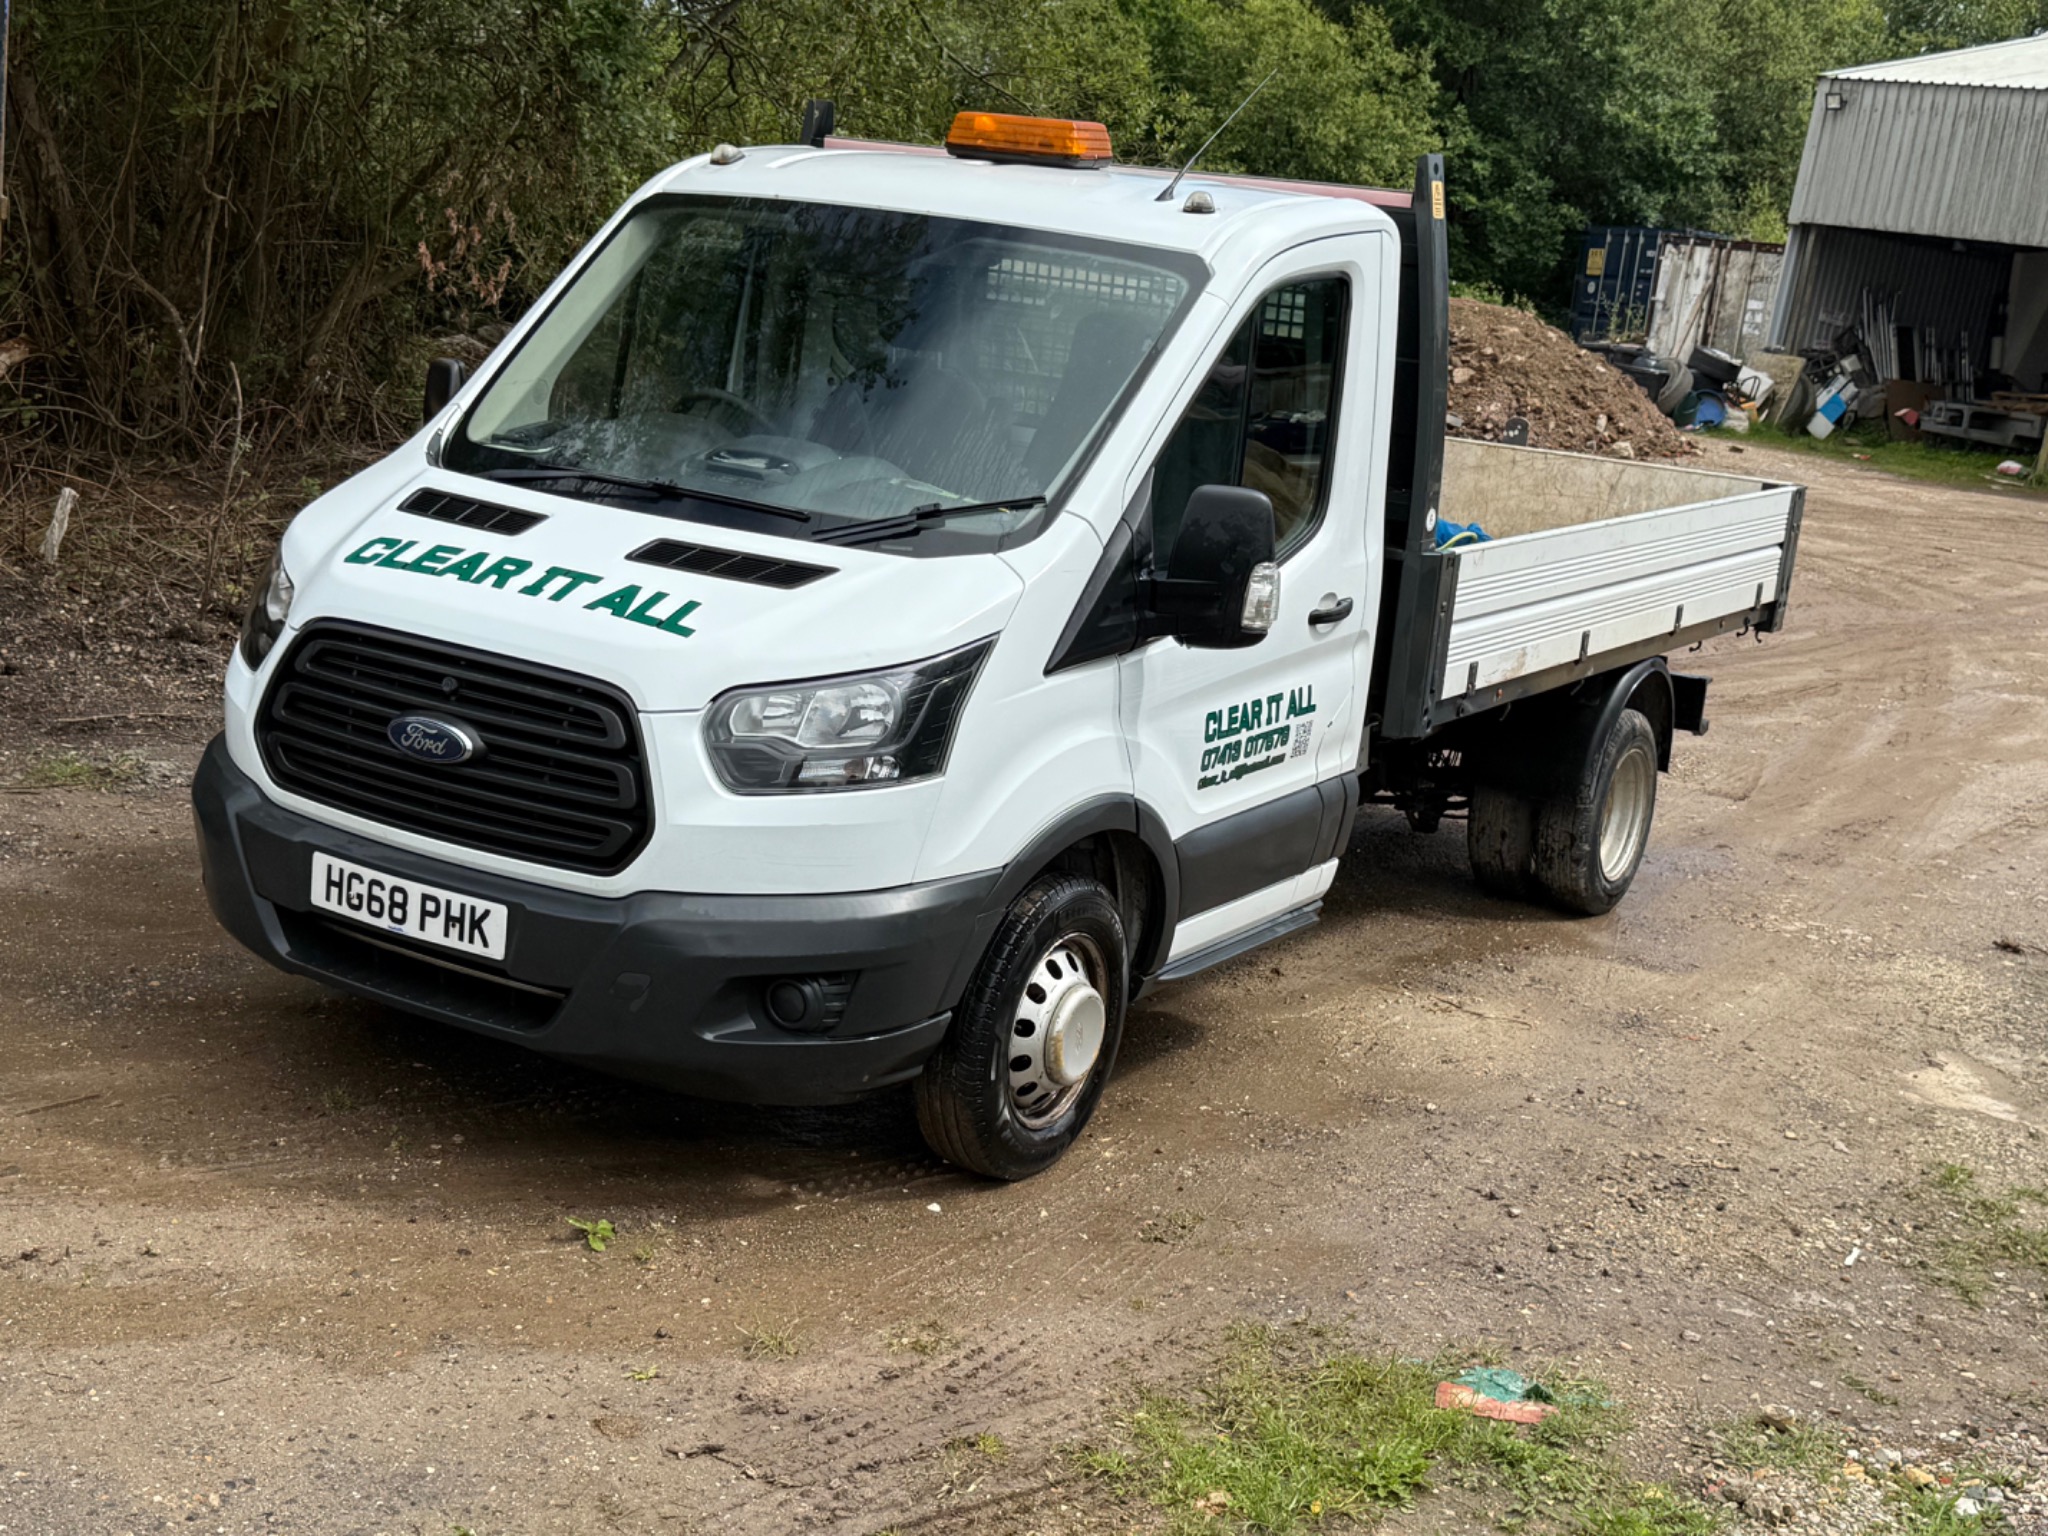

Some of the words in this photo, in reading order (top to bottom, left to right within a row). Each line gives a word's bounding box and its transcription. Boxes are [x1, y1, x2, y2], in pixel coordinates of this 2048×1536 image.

[344, 537, 533, 589] CLEAR
[518, 566, 603, 602] IT
[582, 584, 702, 638] ALL
[400, 723, 448, 755] Ford
[1204, 698, 1262, 743] CLEAR
[1266, 692, 1284, 726] IT
[1285, 684, 1316, 720] ALL
[325, 863, 408, 926] HG68
[418, 892, 491, 949] PHK
